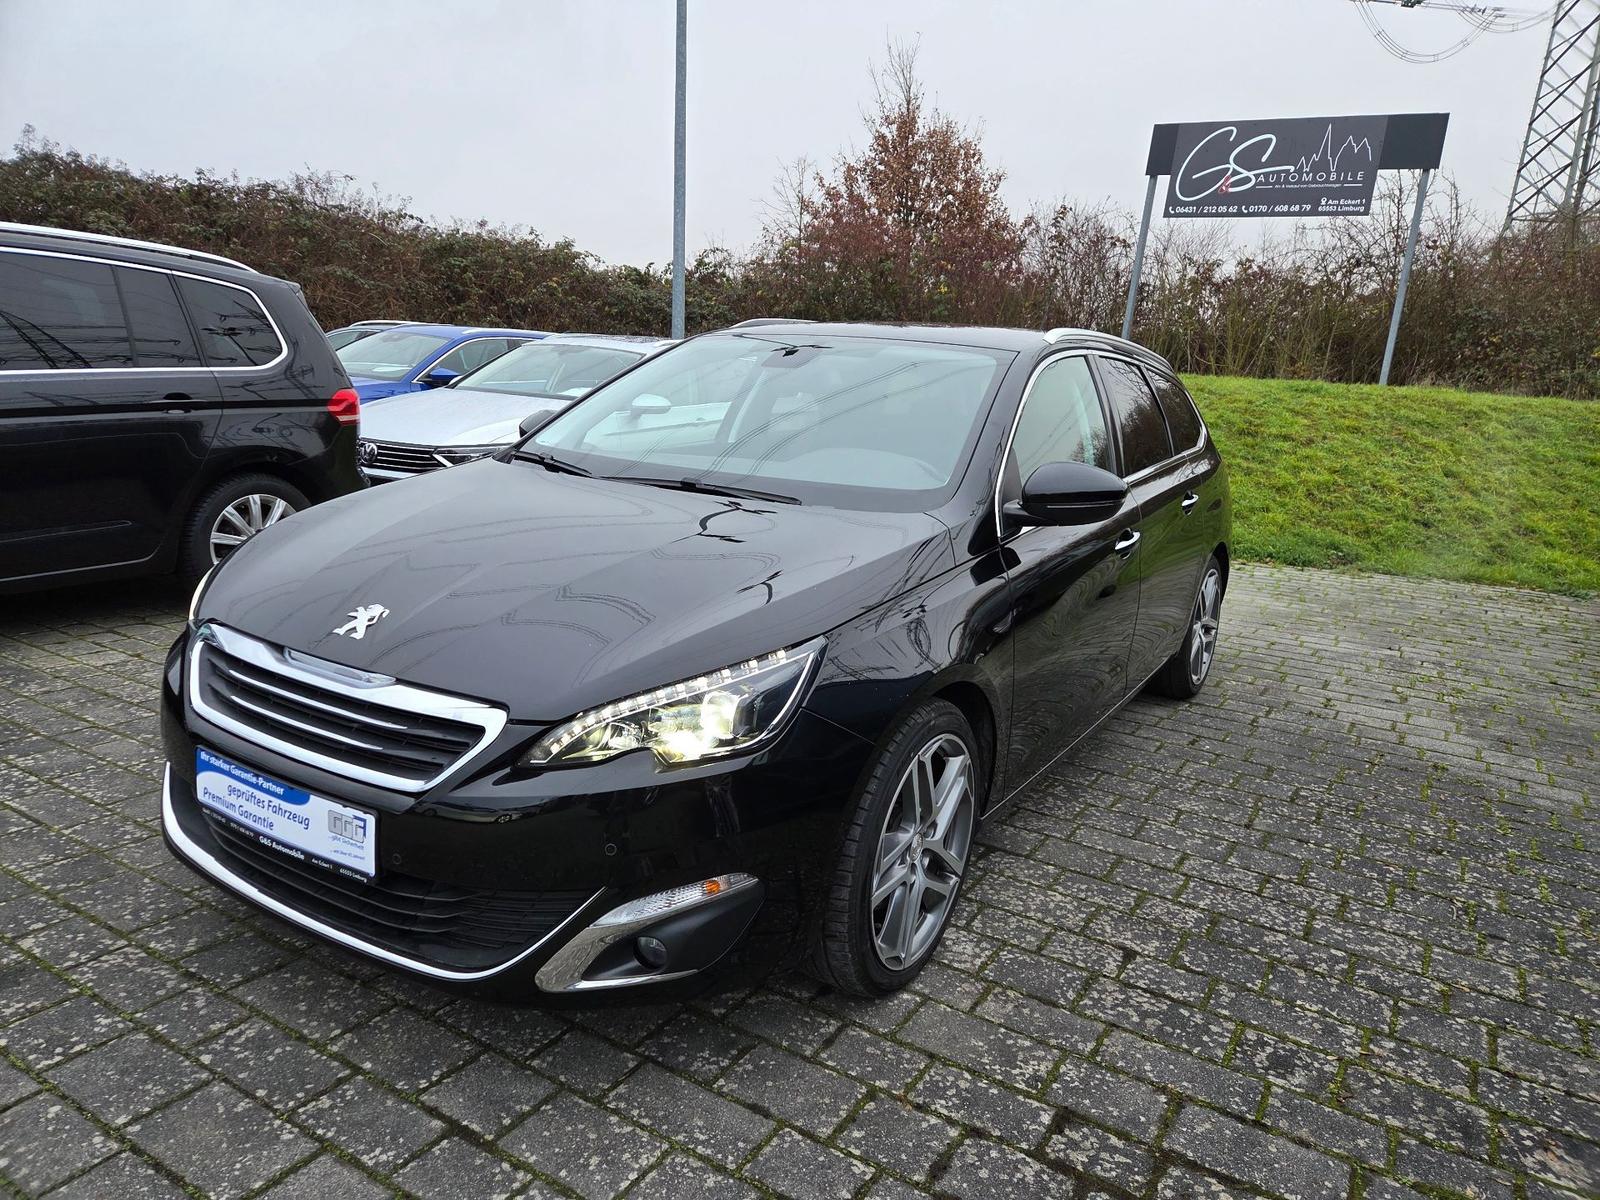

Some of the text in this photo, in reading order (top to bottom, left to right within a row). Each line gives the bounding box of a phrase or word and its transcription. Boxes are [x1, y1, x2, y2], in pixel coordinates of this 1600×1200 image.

[1256, 171, 1365, 182] AUTOMOBILE
[1249, 205, 1268, 213] 0170
[1268, 205, 1274, 213] /
[1301, 204, 1312, 212] 79
[1337, 205, 1365, 213] Limburg
[200, 751, 284, 795] Ihr starker Garantie-Partner
[203, 786, 237, 814] Premium
[237, 805, 274, 831] Garantie
[227, 784, 266, 809] geprüftes
[267, 800, 311, 830] Fahrzeug
